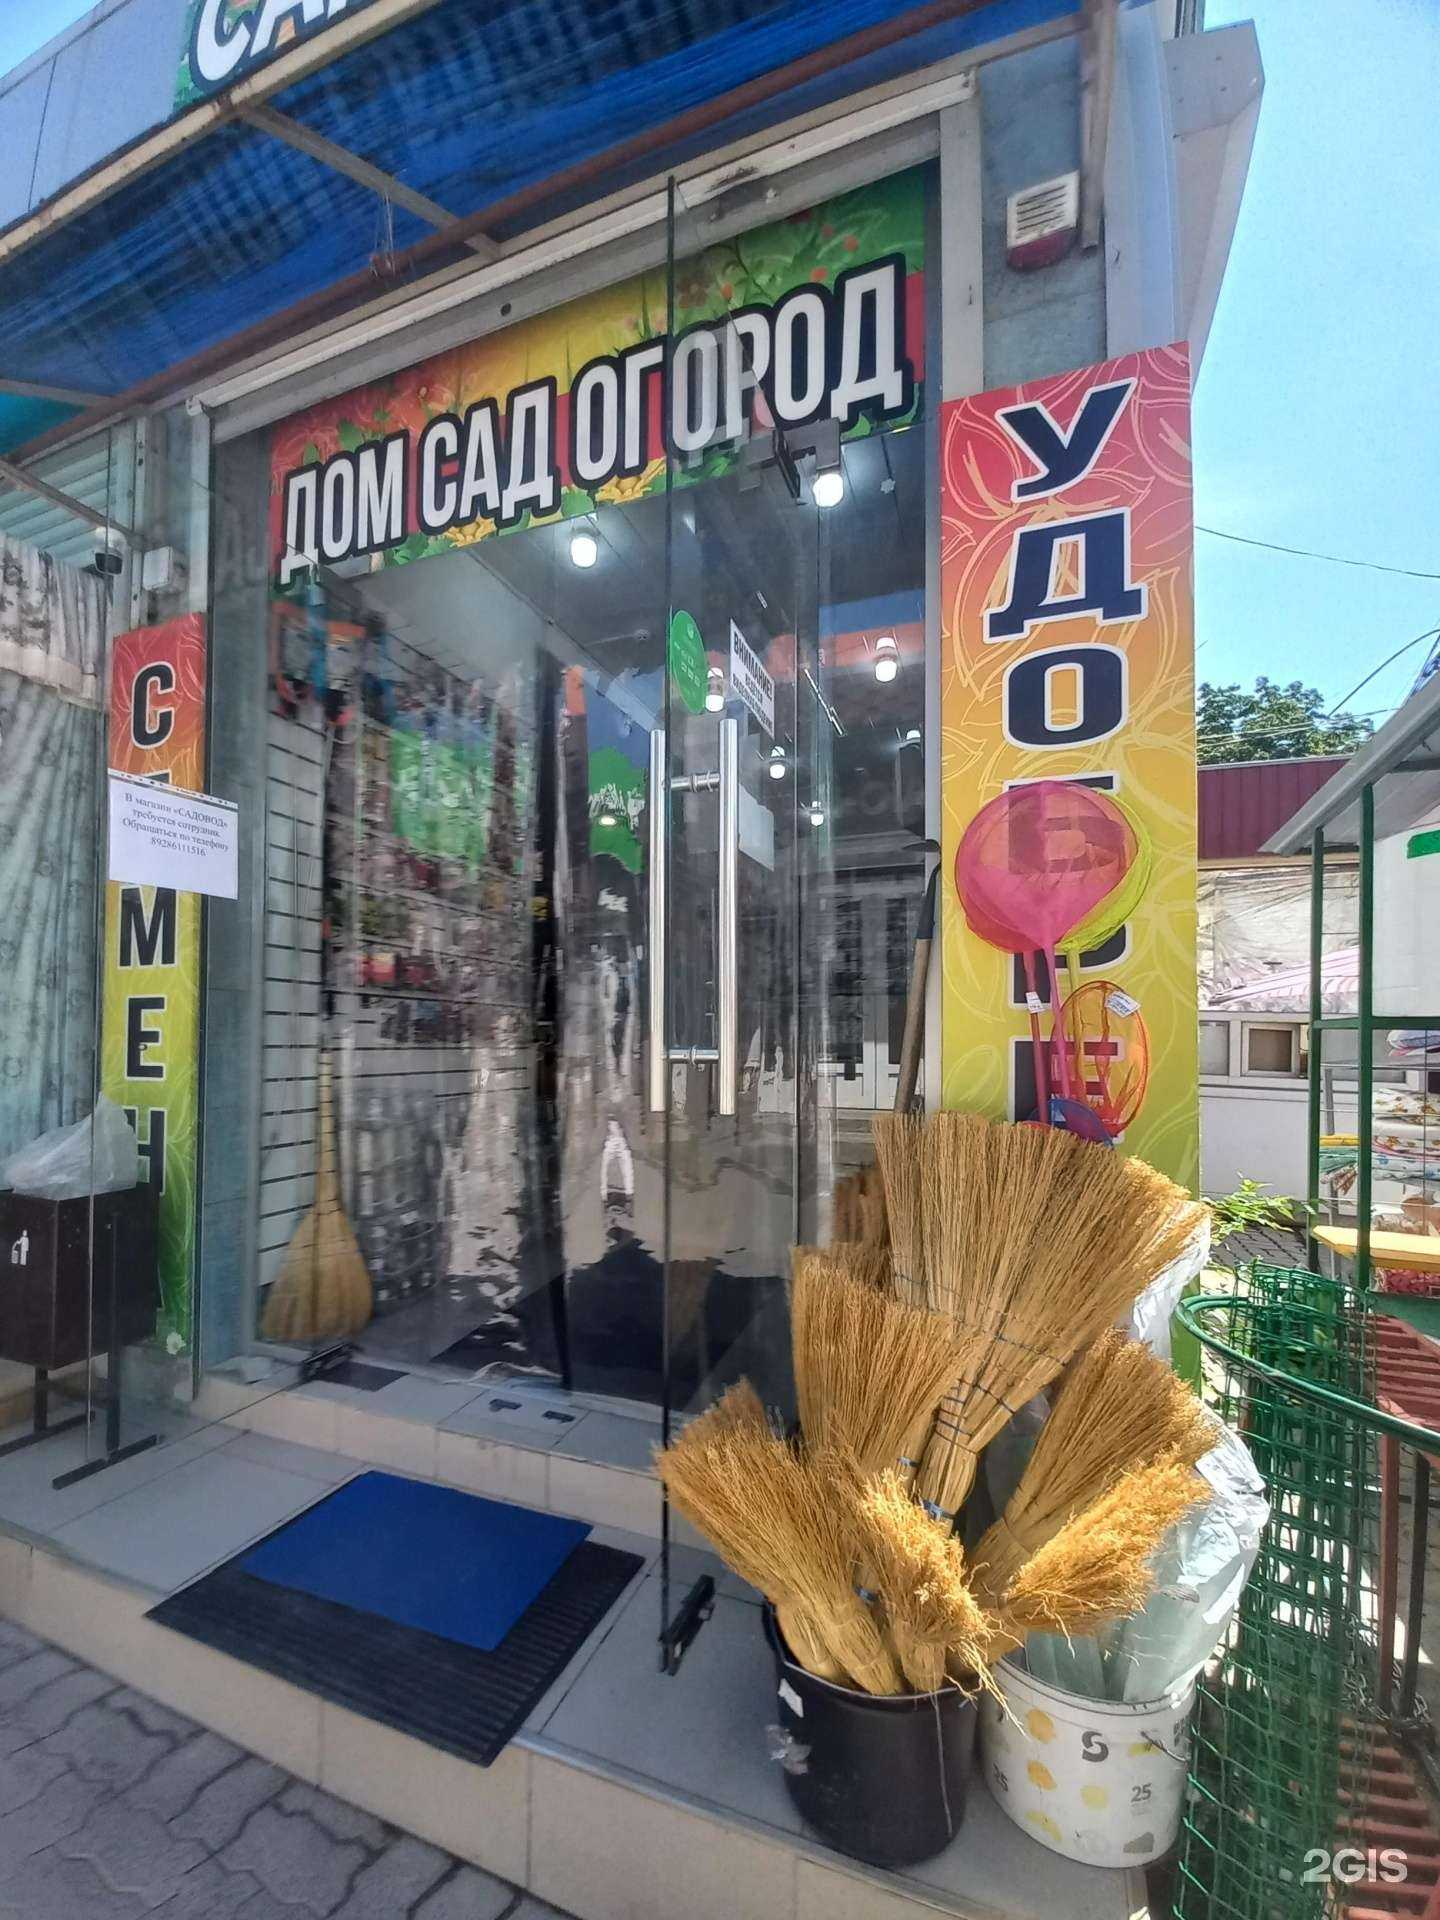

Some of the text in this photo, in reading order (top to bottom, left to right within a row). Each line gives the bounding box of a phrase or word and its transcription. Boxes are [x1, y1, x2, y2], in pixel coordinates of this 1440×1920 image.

[277, 263, 905, 588] ДОМ САД ОГОРОД
[125, 792, 133, 802] В
[135, 797, 172, 813] магазин
[132, 808, 176, 826] требуется
[122, 817, 229, 853] Обращаться по телефону
[1131, 1783, 1152, 1803] 25
